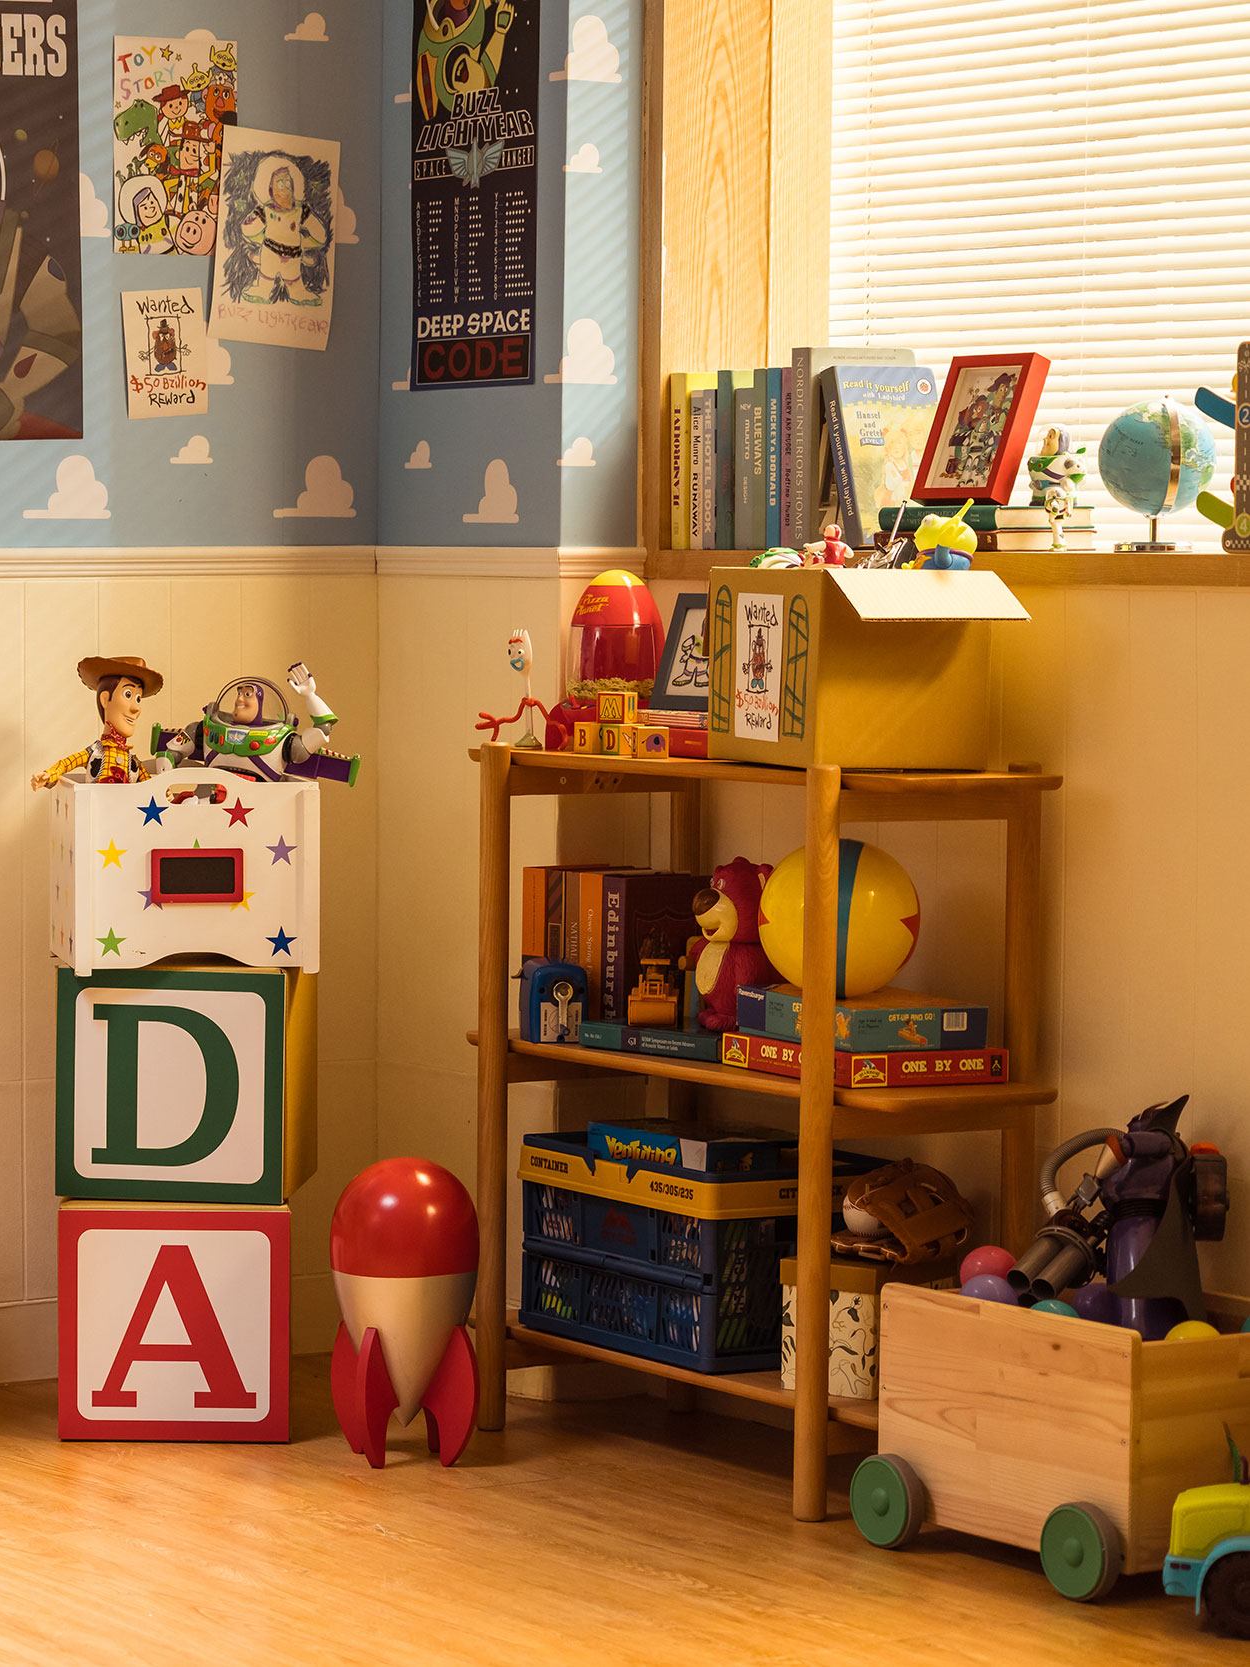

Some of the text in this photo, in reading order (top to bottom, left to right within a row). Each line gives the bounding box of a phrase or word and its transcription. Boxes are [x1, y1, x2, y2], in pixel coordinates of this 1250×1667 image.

[117, 45, 157, 73] TOY
[120, 63, 175, 100] STORY
[450, 87, 502, 120] BUZZ
[415, 109, 534, 152] LIGHTYEAR
[416, 147, 532, 179] SPACE RANGER
[136, 295, 195, 316] Wanted
[218, 303, 253, 322] BUZZ
[417, 308, 530, 338] DEEP SPACE
[424, 337, 524, 379] CODE
[129, 374, 161, 394] $50
[842, 380, 911, 393] Read it yourself
[784, 392, 792, 414] HENRY
[829, 400, 838, 423] Read
[856, 411, 881, 419] Hansel
[692, 406, 701, 431] Alice
[769, 398, 777, 445] MICKEY
[784, 417, 792, 431] AND
[1242, 408, 1250, 423] 2
[753, 407, 762, 475] BLUEWAYS
[859, 428, 883, 437] Gretel
[692, 435, 701, 465] Munro
[795, 357, 804, 540] NORDIC INTERIORS HOMES
[833, 431, 846, 466] yourself
[704, 399, 712, 534] THE HOTEL BOOK
[840, 467, 848, 485] with
[769, 454, 777, 506] DONALD
[691, 473, 699, 537] RUNAWAY
[844, 486, 854, 517] laybird
[1239, 521, 1248, 533] 4
[582, 593, 609, 605] Pizza
[744, 600, 779, 626] Wanted
[599, 697, 623, 719] M
[578, 728, 587, 747] B
[606, 729, 616, 750] D
[585, 935, 594, 965] Spring
[602, 891, 620, 1023] Edinburgh
[910, 1013, 923, 1021] AND
[760, 1045, 778, 1059] ONE
[781, 1048, 794, 1062] BY
[901, 1058, 984, 1073] ONE BY ONE
[91, 1002, 240, 1168] D
[530, 1155, 569, 1174] CONTAINER
[649, 1180, 694, 1200] 435/305/235
[779, 1187, 798, 1199] CIT
[91, 1244, 257, 1409] A
